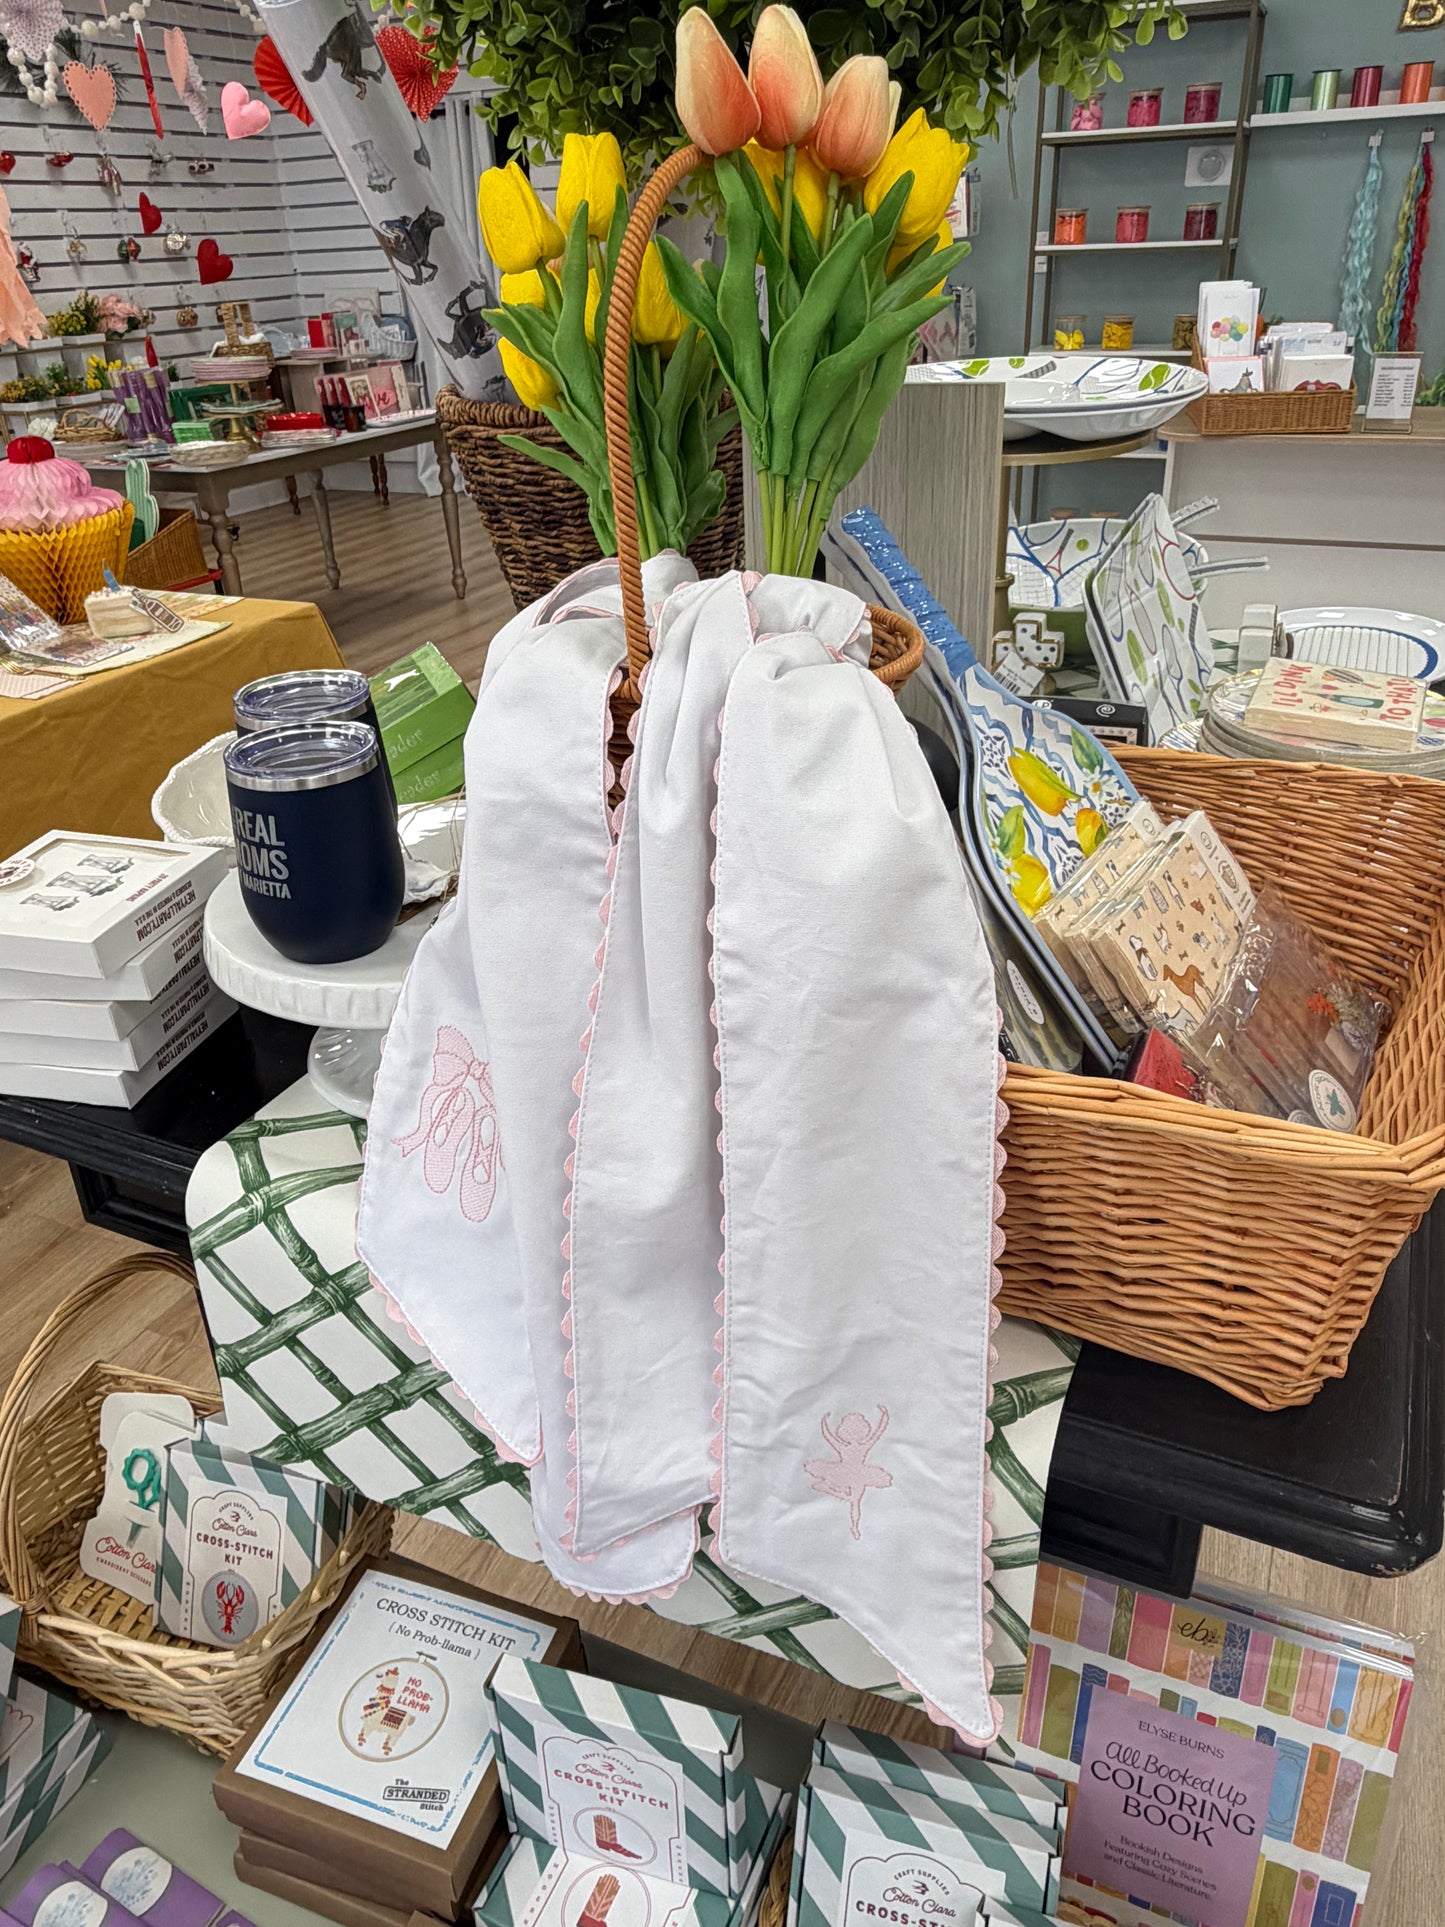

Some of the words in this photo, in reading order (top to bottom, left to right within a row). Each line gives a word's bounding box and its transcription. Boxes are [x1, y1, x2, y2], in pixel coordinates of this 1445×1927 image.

[1379, 707, 1412, 721] TO
[389, 729, 424, 758] ader
[399, 769, 440, 802] eader
[234, 806, 286, 847] REAL
[242, 872, 292, 900] MARIETTA
[136, 889, 197, 942] HEYYALLPARTY.COM
[173, 926, 204, 963] LLPARTY.COM
[157, 1019, 209, 1071] HEYYALLPARTY.COM
[212, 1518, 235, 1531] Cotton
[95, 1536, 131, 1560] Cotton
[196, 1532, 274, 1560] CROSS-STITCH
[224, 1553, 243, 1566] KIT
[376, 1598, 429, 1622] CROSS
[429, 1614, 487, 1642] STITCH
[487, 1632, 517, 1651] KIT
[395, 1624, 411, 1638] No
[412, 1629, 473, 1658] Prob-llama
[396, 1695, 431, 1714] LLAMA
[401, 1685, 434, 1702] PROB-
[1138, 1720, 1178, 1742] ELYSE
[1179, 1735, 1225, 1759] BURNS
[395, 1778, 409, 1786] The
[553, 1769, 669, 1810] CROSS-STITCH
[575, 1763, 609, 1779] Cotton
[611, 1774, 644, 1789] Clara
[1143, 1754, 1215, 1797] Booked
[1217, 1781, 1247, 1808] Up
[386, 1788, 447, 1801] STRANDED
[419, 1803, 444, 1812] Stitch
[598, 1792, 625, 1807] KIT
[1090, 1760, 1257, 1836] COLORING
[1122, 1794, 1215, 1848] BOOK
[1104, 1840, 1150, 1866] Featuring
[1152, 1860, 1179, 1876] Cozy
[1179, 1870, 1217, 1891] Scenes
[1120, 1835, 1160, 1857] Bookish
[1162, 1851, 1203, 1874] Designs
[893, 1868, 915, 1881] CRAFT
[917, 1869, 951, 1896] SUPPLIES
[1103, 1853, 1123, 1865] and
[1124, 1860, 1161, 1880] Classic
[1162, 1874, 1213, 1900] Literature
[856, 1900, 945, 1927] CROSS-ST
[882, 1886, 920, 1907] Cotton
[921, 1899, 957, 1917] Clara
